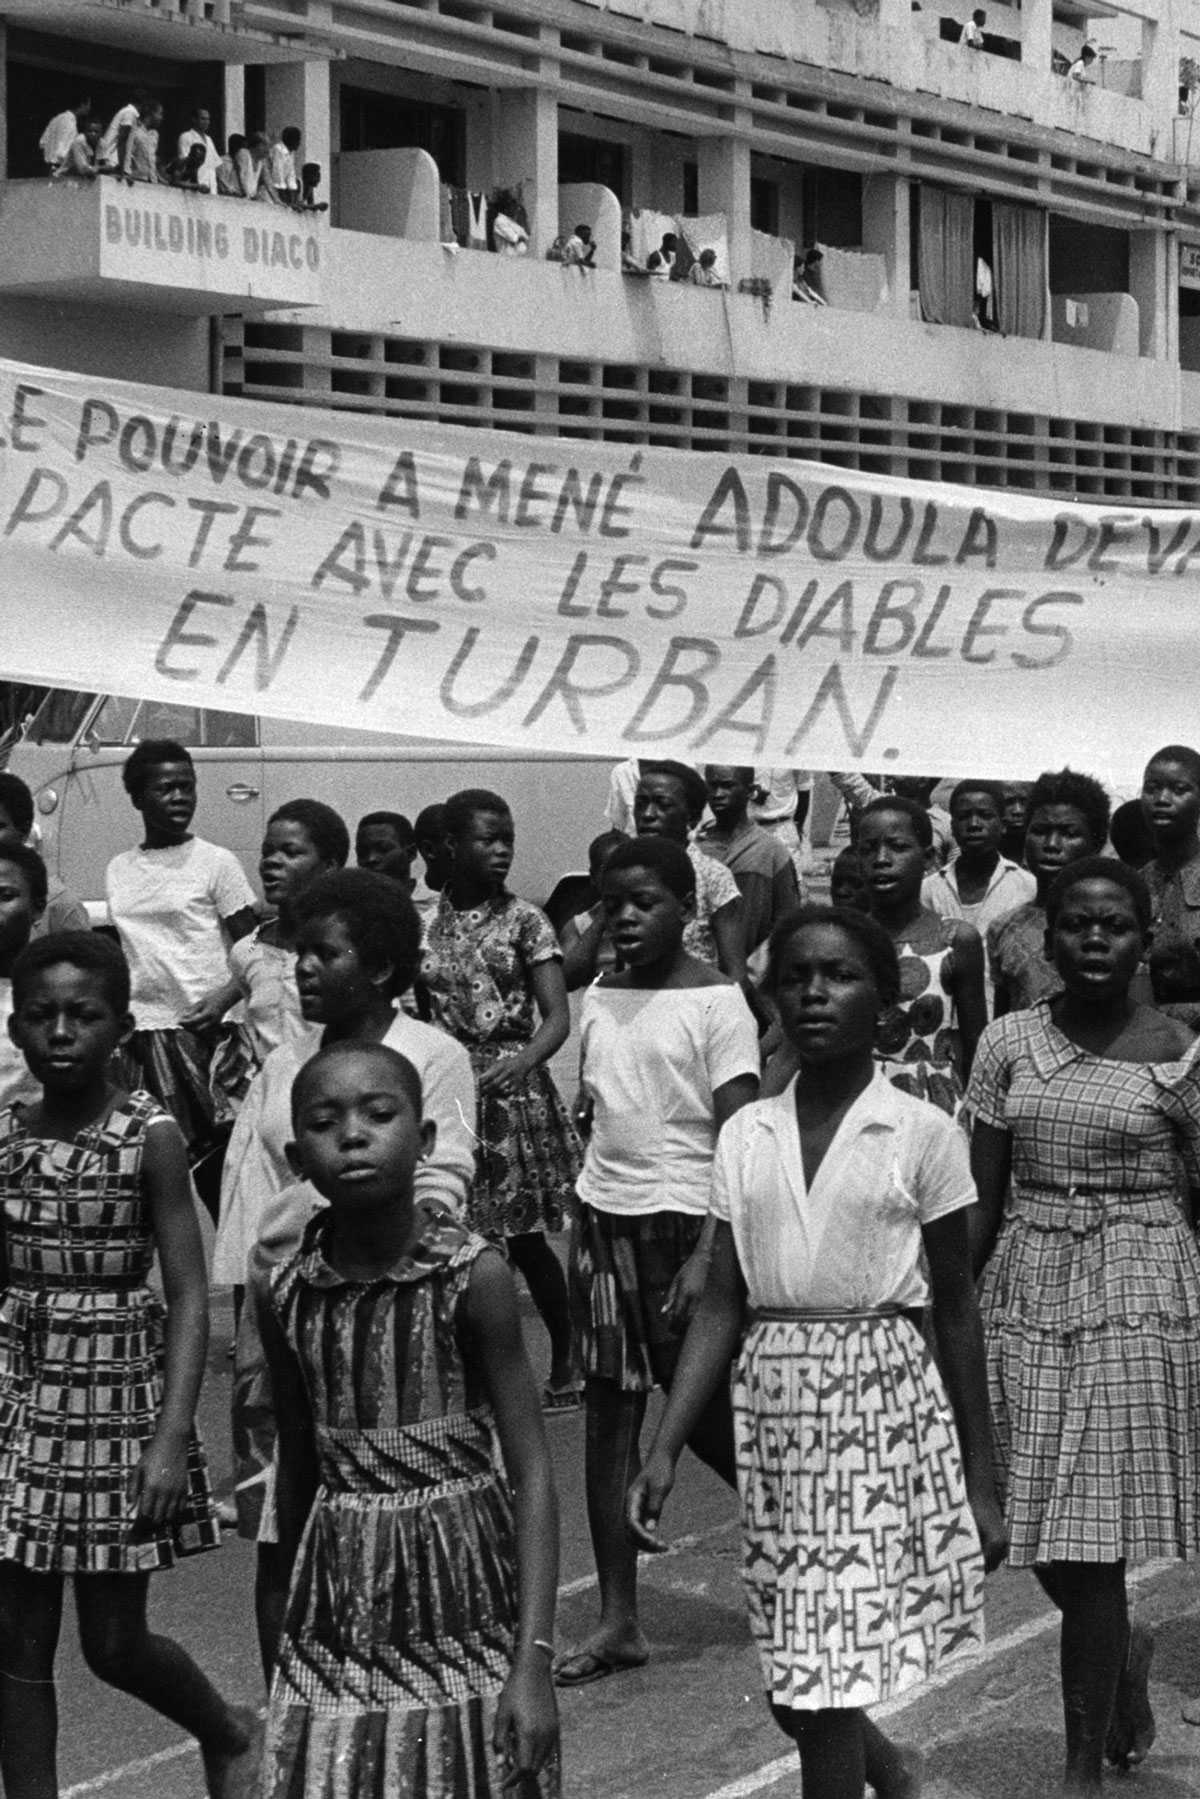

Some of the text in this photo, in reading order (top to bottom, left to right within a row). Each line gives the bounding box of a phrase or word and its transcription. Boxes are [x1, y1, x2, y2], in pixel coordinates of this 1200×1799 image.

[105, 204, 321, 273] BUILDING DIACO
[0, 384, 47, 452] E
[75, 398, 341, 498] POUVOIR
[376, 450, 420, 520] A
[454, 450, 646, 537] MENÉ
[689, 466, 998, 568] ADOULA
[4, 467, 1084, 669] PACTE AVEC LES DIABLES
[154, 589, 900, 760] EN TURBAN.
